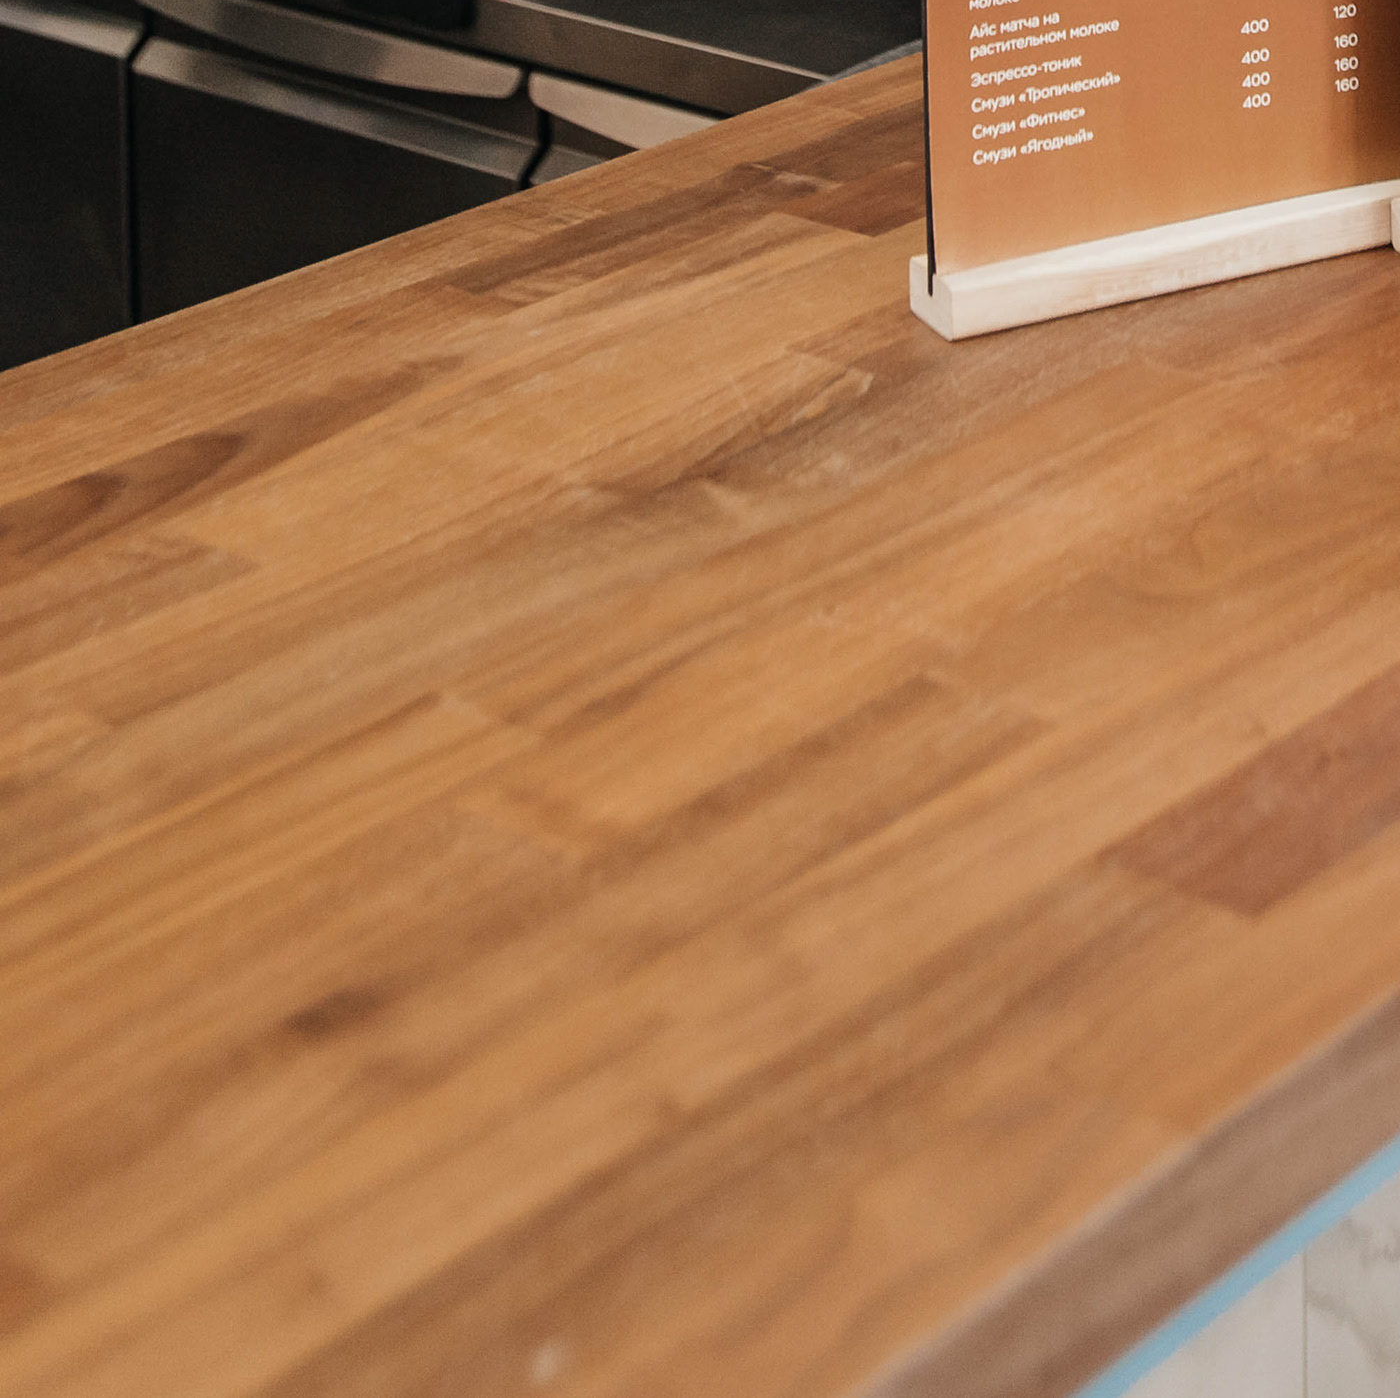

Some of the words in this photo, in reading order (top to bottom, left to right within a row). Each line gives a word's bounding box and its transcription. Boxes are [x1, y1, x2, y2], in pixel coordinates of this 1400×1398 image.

[970, 21, 996, 39] Айс
[1000, 12, 1040, 34] матча
[1043, 11, 1060, 24] на
[970, 29, 1066, 60] растительном
[1070, 19, 1119, 38] молоке
[971, 54, 1082, 88] Эспрессо-тоник
[972, 95, 1015, 114] Смузи
[1019, 72, 1121, 105] «Тропический»
[972, 121, 1015, 139] Смузи
[1019, 106, 1085, 130] «Фитнес»
[973, 146, 1016, 165] Смузи
[1021, 129, 1093, 155] «Ягодный»
